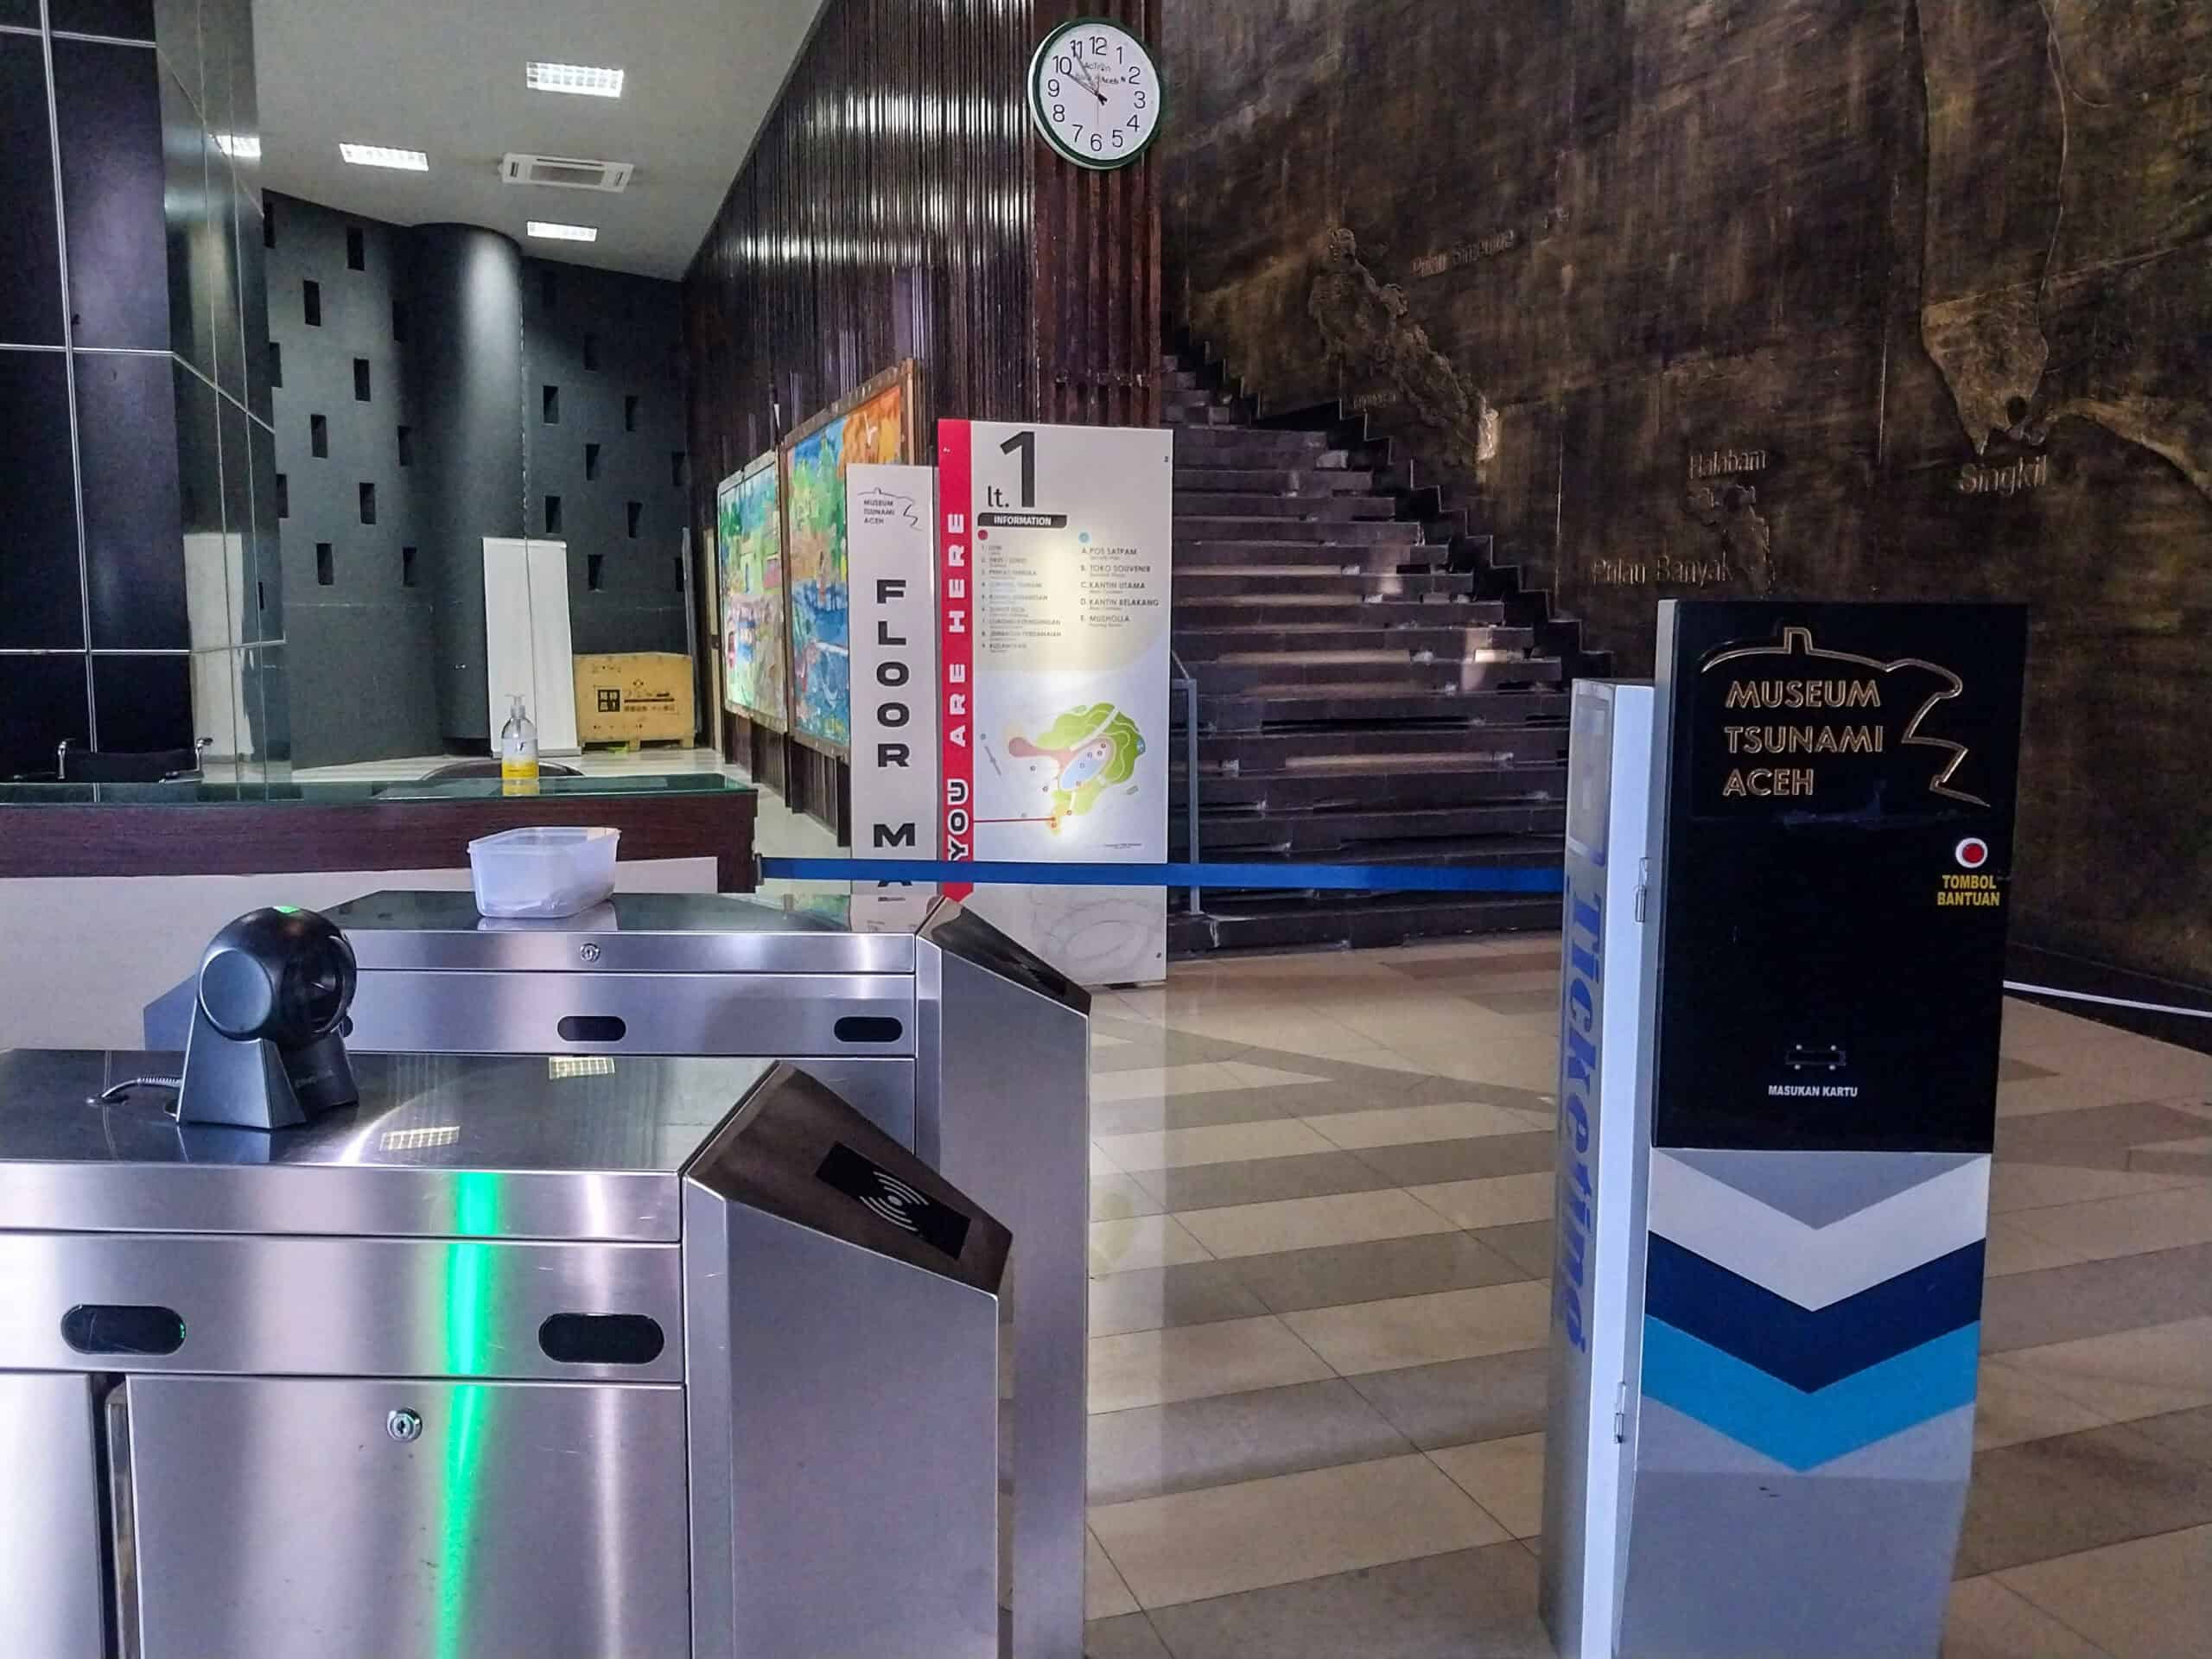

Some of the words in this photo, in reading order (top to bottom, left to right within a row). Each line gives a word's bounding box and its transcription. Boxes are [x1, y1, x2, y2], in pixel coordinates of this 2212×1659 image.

[1070, 39, 1083, 60] 11
[1089, 35, 1108, 56] 12
[1116, 46, 1123, 65] 1
[1052, 55, 1072, 75] 10
[1128, 66, 1141, 85] 2
[1047, 79, 1060, 98] 9
[1133, 90, 1147, 110] 3
[1052, 104, 1065, 123] 8
[1126, 114, 1141, 132] 4
[1071, 124, 1084, 143] 7
[1090, 132, 1103, 152] 6
[1111, 129, 1124, 149] 5
[999, 430, 1035, 508] 1
[1959, 454, 2046, 498] Singkil
[993, 515, 1052, 526] INFORMATION
[1107, 547, 1137, 556] SATPAM
[947, 513, 966, 634] HERE
[1089, 598, 1117, 607] KANTIN
[1089, 614, 1130, 623] MUSHOLLA
[875, 578, 911, 769] FLOOR
[1724, 679, 1882, 709] MUSEUM
[949, 664, 966, 747] ARE
[1723, 725, 1885, 753] TSUNAMI
[1722, 767, 1815, 797] ACEH
[947, 779, 969, 861] YOU
[1941, 874, 1998, 891] TOMBOL
[1936, 891, 2001, 907] BANTUAN
[1768, 1084, 1821, 1096] MASUKAN
[1821, 1086, 1859, 1098] KARTU
[1563, 892, 1603, 1354] Ticketing
